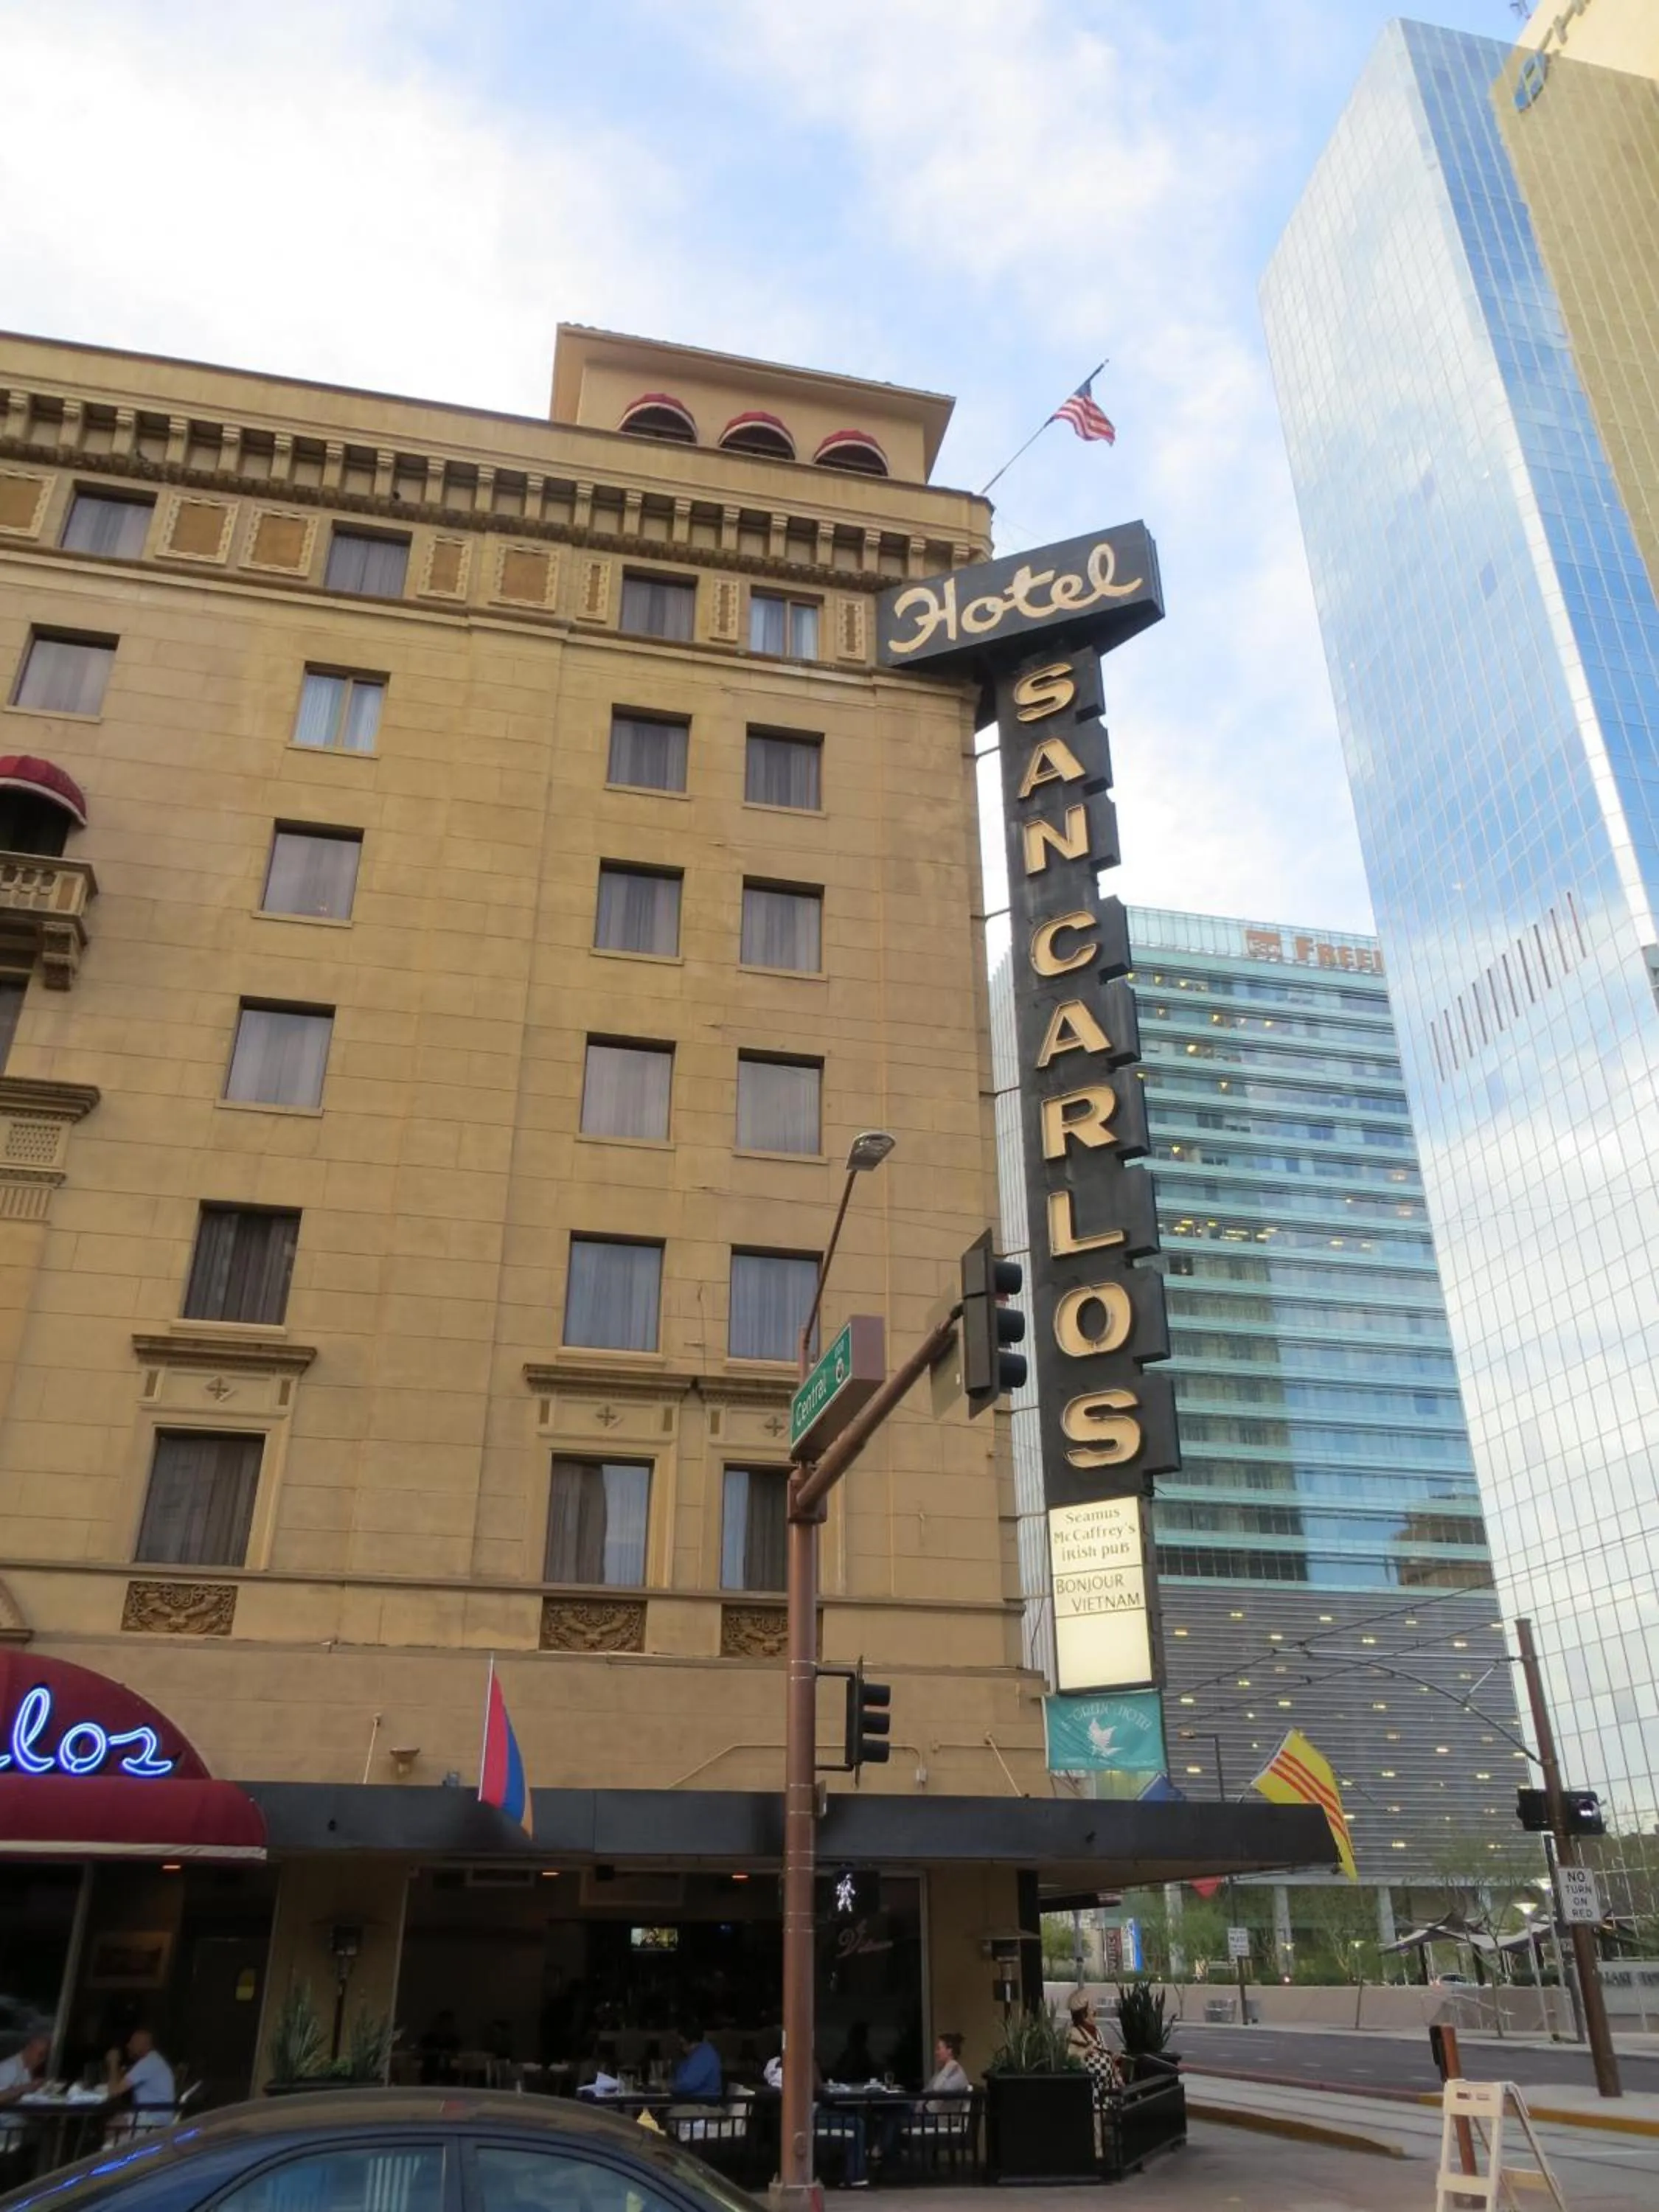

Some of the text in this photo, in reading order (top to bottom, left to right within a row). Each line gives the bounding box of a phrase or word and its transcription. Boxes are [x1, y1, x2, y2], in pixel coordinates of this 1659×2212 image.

[887, 543, 1144, 655] Hotel
[1013, 661, 1142, 1469] SAN CARLOS
[796, 1369, 827, 1427] Central
[1065, 1509, 1120, 1524] Seamus
[1054, 1521, 1136, 1544] McCaffrey's
[1055, 1573, 1125, 1594] BONJOUR
[1071, 1593, 1141, 1612] VIETNAM
[0, 1688, 173, 1775] los
[1568, 1871, 1585, 1882] NO
[1565, 1885, 1592, 1894] TURN
[1573, 1897, 1587, 1906] ON
[1572, 1909, 1593, 1918] RED
